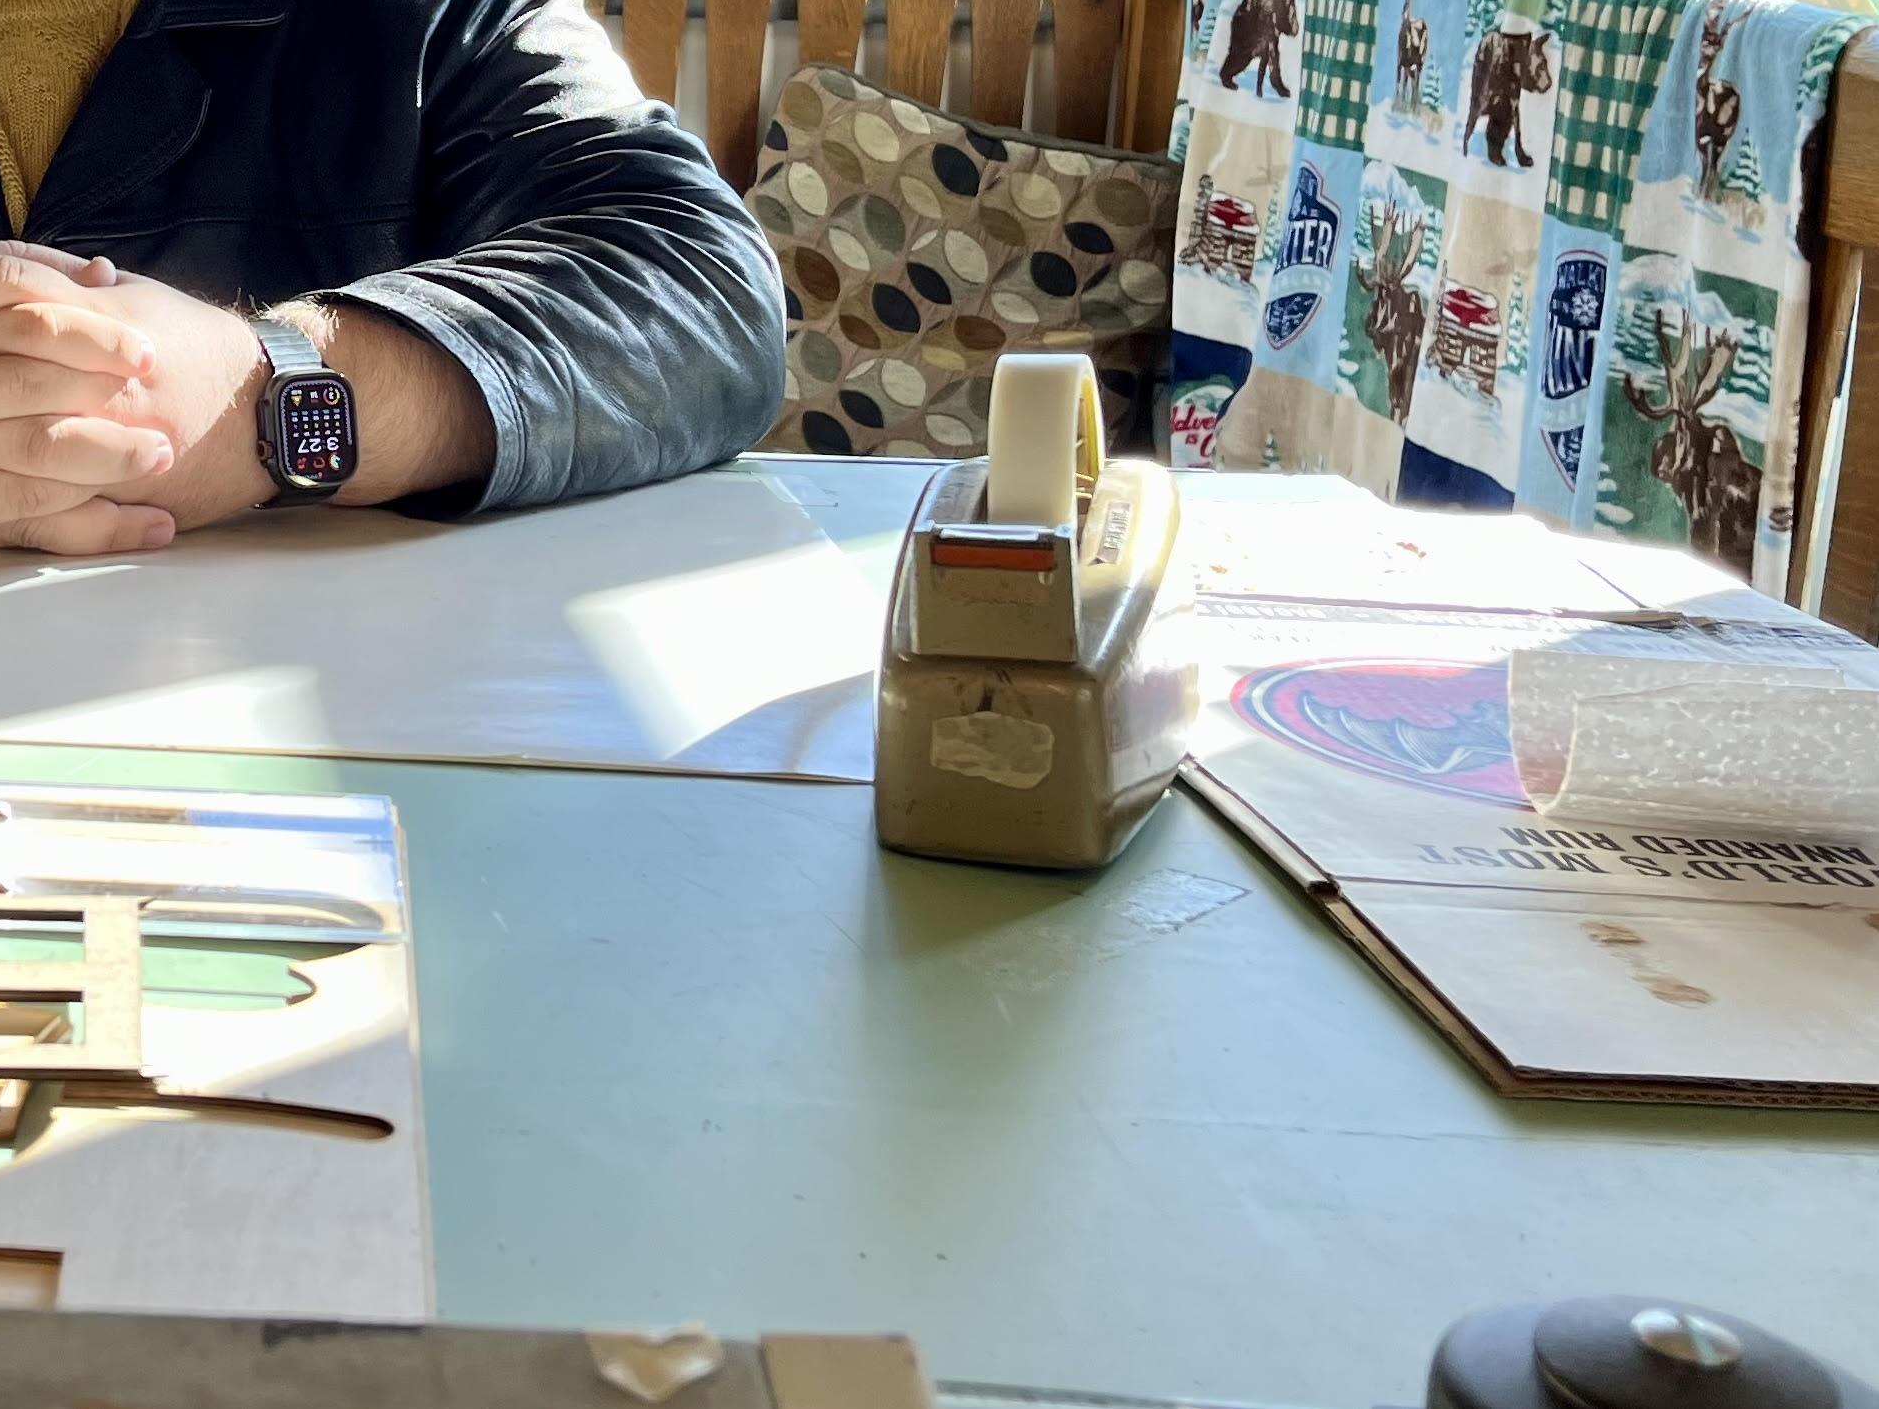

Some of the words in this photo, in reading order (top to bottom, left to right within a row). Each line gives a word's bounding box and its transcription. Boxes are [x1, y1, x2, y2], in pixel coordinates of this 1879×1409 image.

[297, 436, 340, 454] 3:27
[1500, 826, 1626, 852] RUM
[1631, 835, 1876, 866] AWARDED
[1415, 843, 1612, 875] MOST
[1621, 856, 1879, 888] ORLD'S
